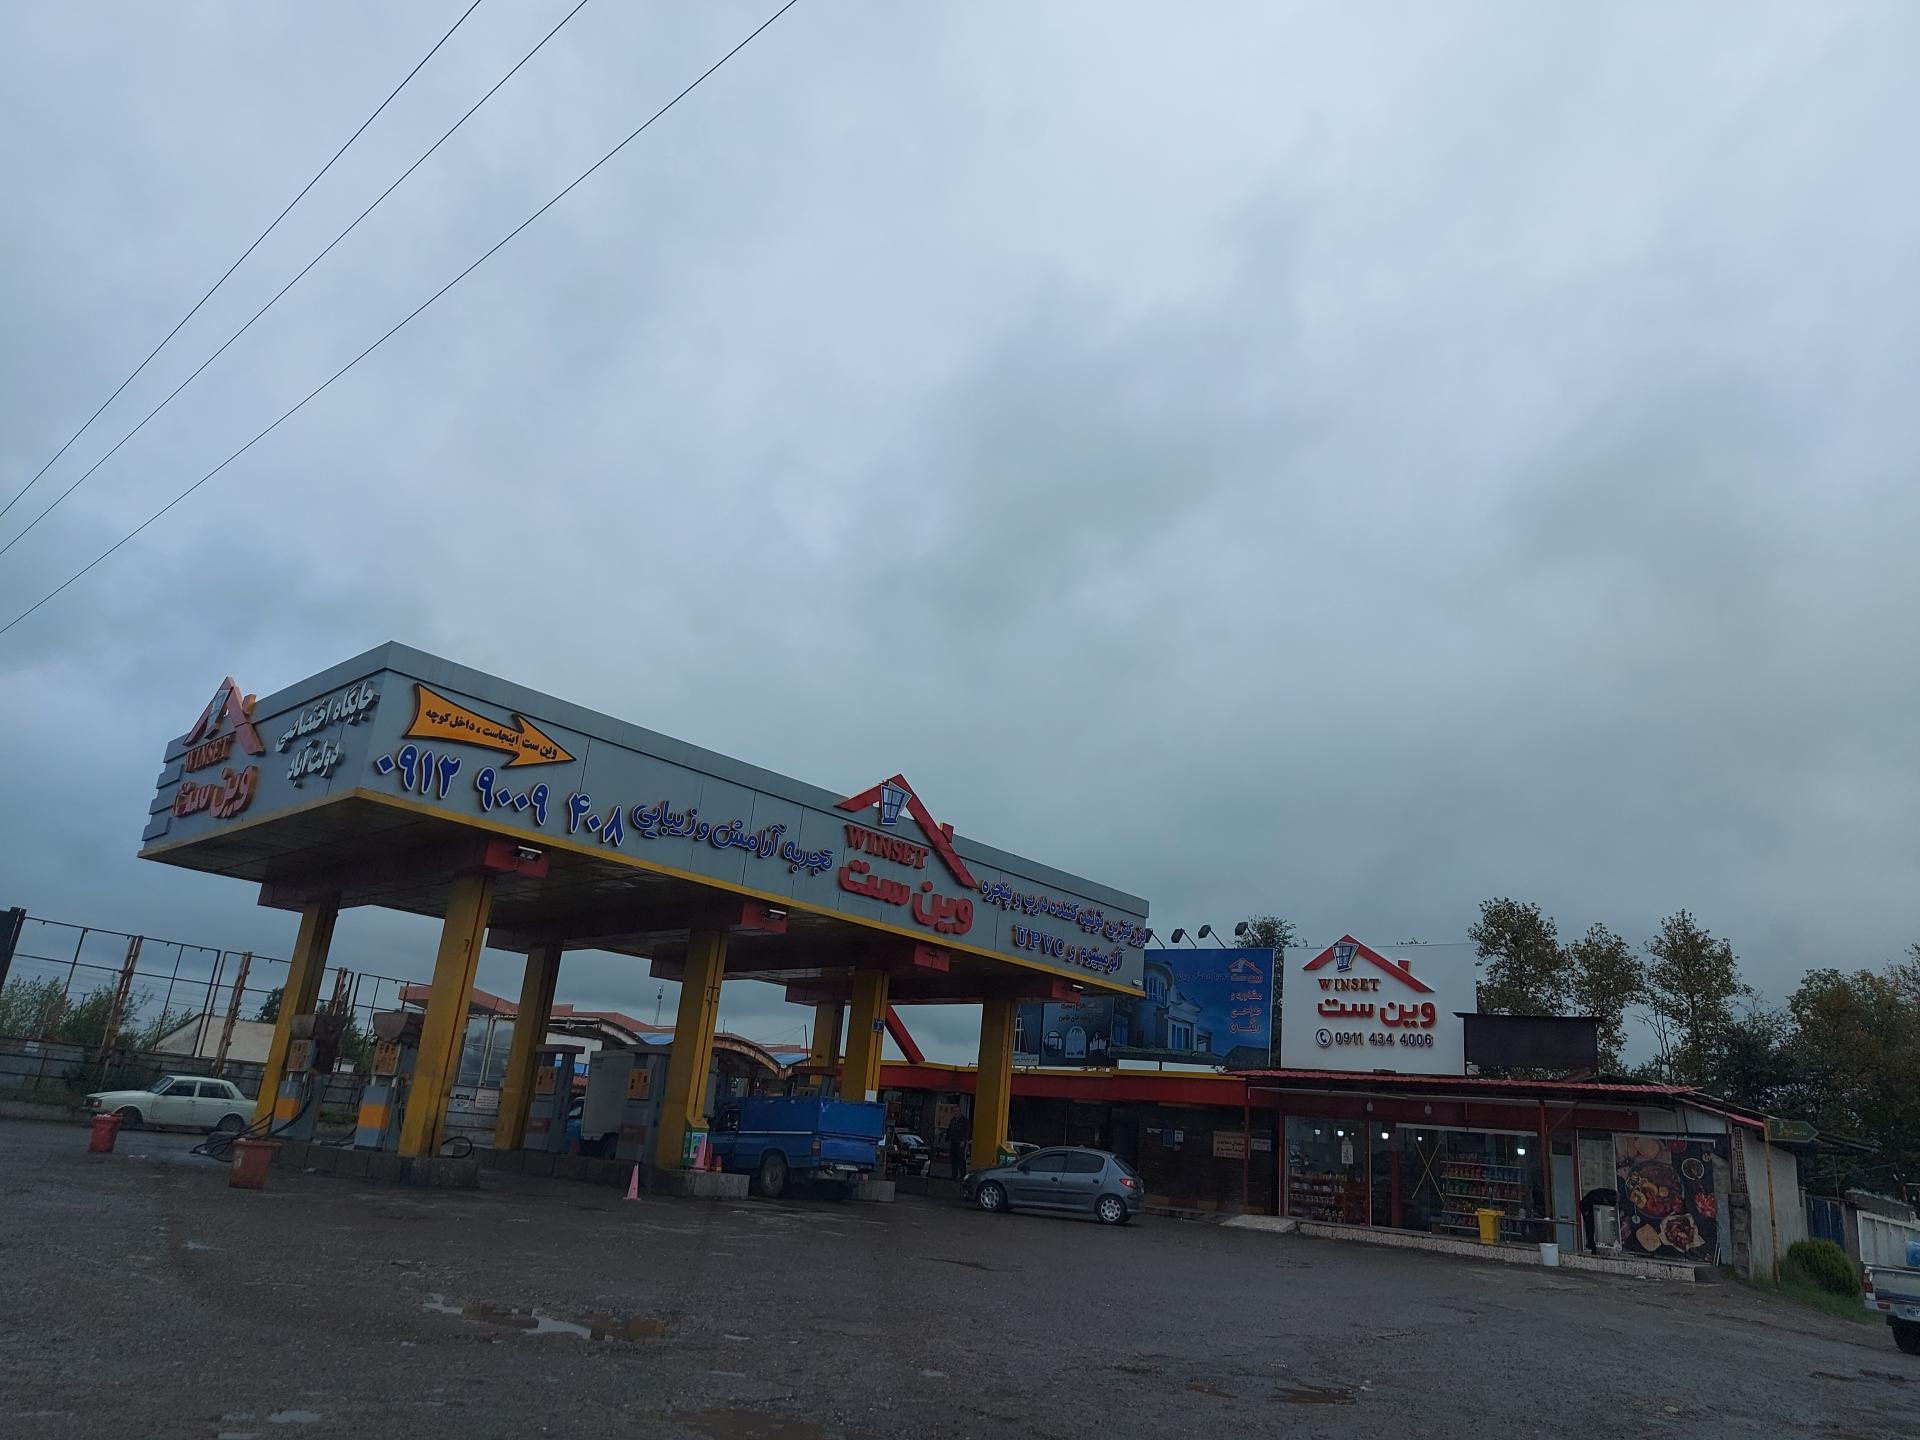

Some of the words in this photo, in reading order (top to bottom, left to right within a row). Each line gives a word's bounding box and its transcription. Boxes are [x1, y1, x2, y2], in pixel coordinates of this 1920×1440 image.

[425, 709, 451, 724] کوچه
[450, 716, 475, 731] داخل
[522, 739, 539, 751] ست
[539, 746, 558, 759] وین
[173, 782, 211, 817] ست
[209, 766, 259, 818] وین
[632, 800, 698, 839] زیبایی
[697, 821, 711, 841] و
[712, 819, 787, 858] آرامش
[847, 823, 929, 868] WINSET
[783, 840, 834, 876] تجربه
[838, 859, 911, 905] ست
[912, 881, 974, 934] وین
[981, 880, 1012, 911] پنجره
[1014, 893, 1021, 909] و
[1049, 902, 1079, 920] کننده
[1079, 908, 1104, 933] تولید
[1015, 925, 1064, 956] UPVC
[1068, 945, 1076, 961] و
[1318, 978, 1381, 992] WINSET
[1317, 998, 1375, 1018] ست
[1379, 1002, 1436, 1028] وین
[1335, 1032, 1363, 1046] 0911
[1369, 1033, 1395, 1046] 434
[1400, 1033, 1434, 1047] 4006
